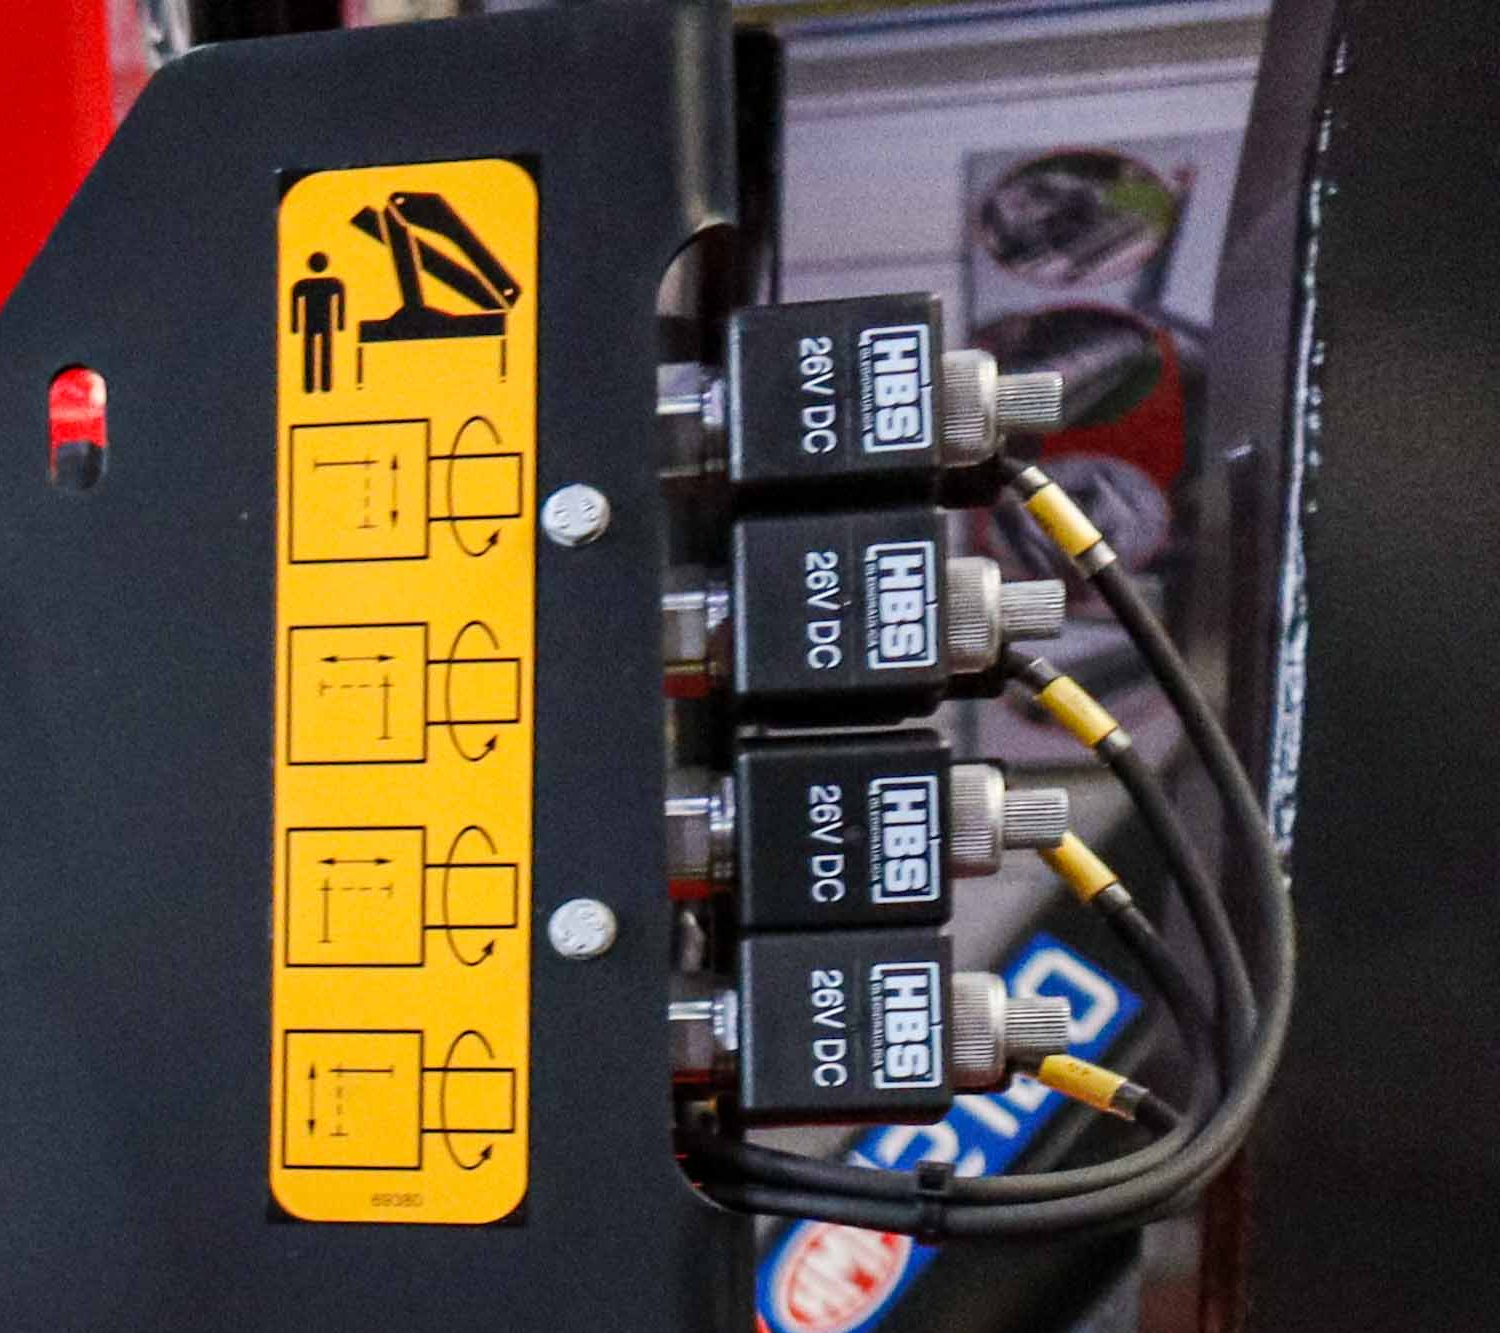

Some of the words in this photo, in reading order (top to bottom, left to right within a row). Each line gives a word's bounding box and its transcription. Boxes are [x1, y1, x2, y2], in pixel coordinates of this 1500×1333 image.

[799, 336, 835, 395] 26V
[873, 335, 920, 442] HBS
[802, 407, 838, 454] DC
[805, 551, 838, 611] 26V
[878, 552, 924, 657] HBS
[808, 620, 841, 670] DC
[809, 784, 842, 845] 26V
[883, 784, 930, 890] HBS
[811, 854, 845, 903] DC
[811, 969, 844, 1029] 26V
[884, 972, 931, 1079] HBS
[813, 1039, 847, 1088] DC
